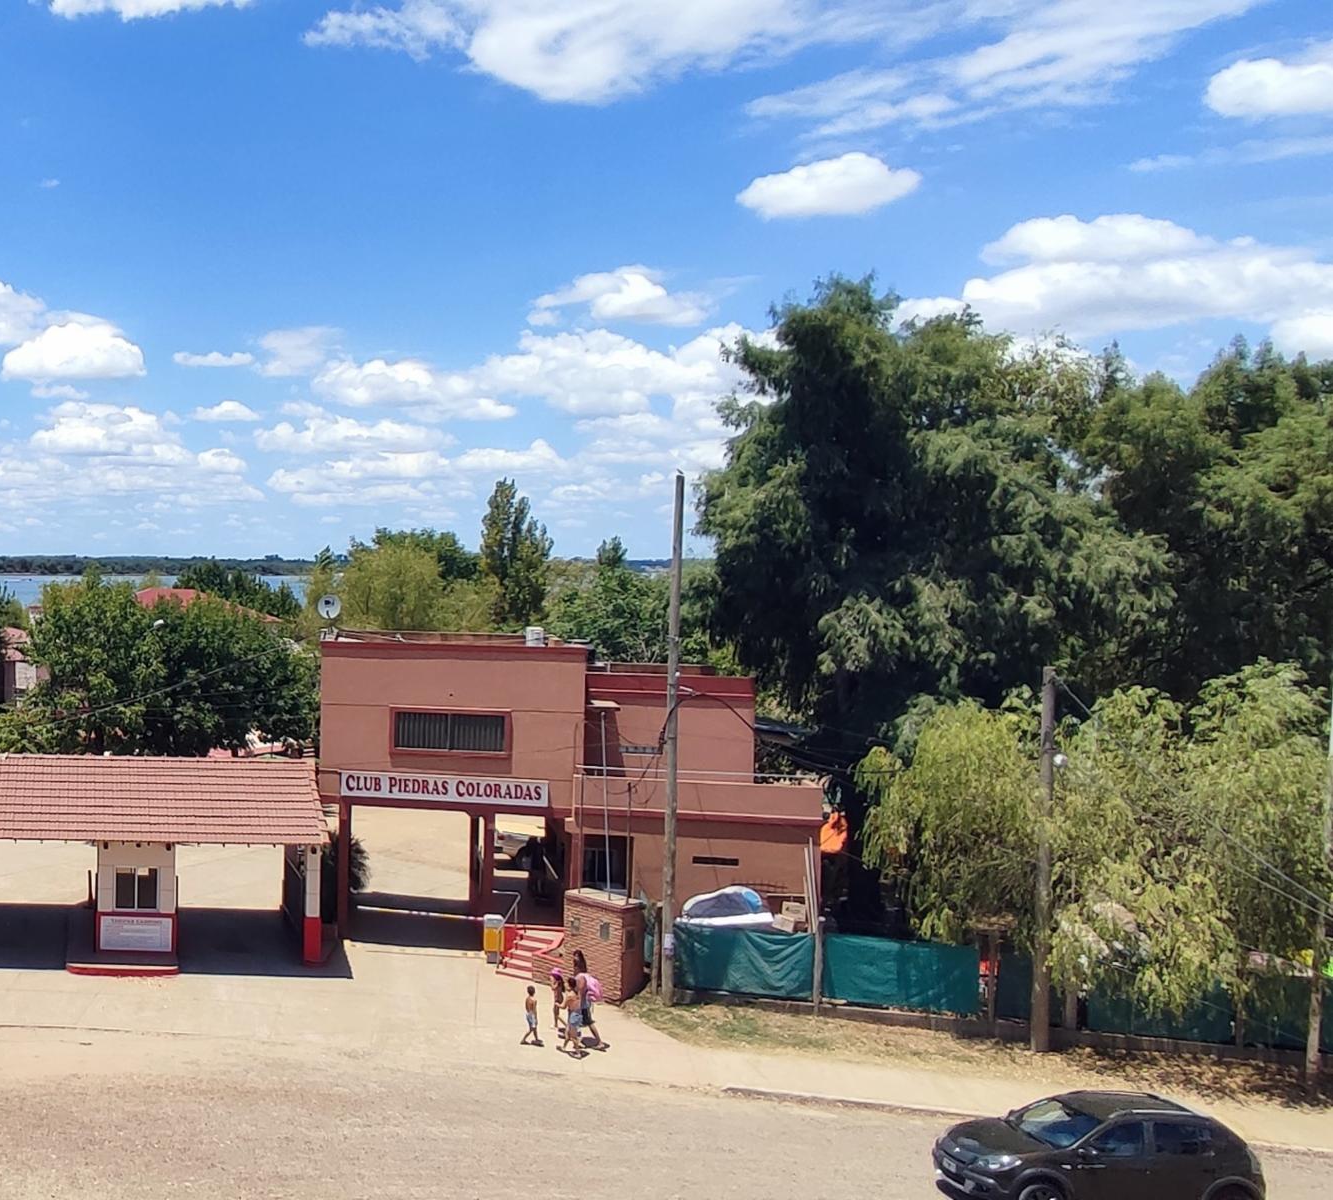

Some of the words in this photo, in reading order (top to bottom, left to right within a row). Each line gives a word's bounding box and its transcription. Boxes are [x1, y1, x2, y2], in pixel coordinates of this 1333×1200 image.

[345, 774, 382, 792] CLUB
[388, 776, 449, 796] PIEDRAS
[455, 780, 542, 801] COLORADAS
